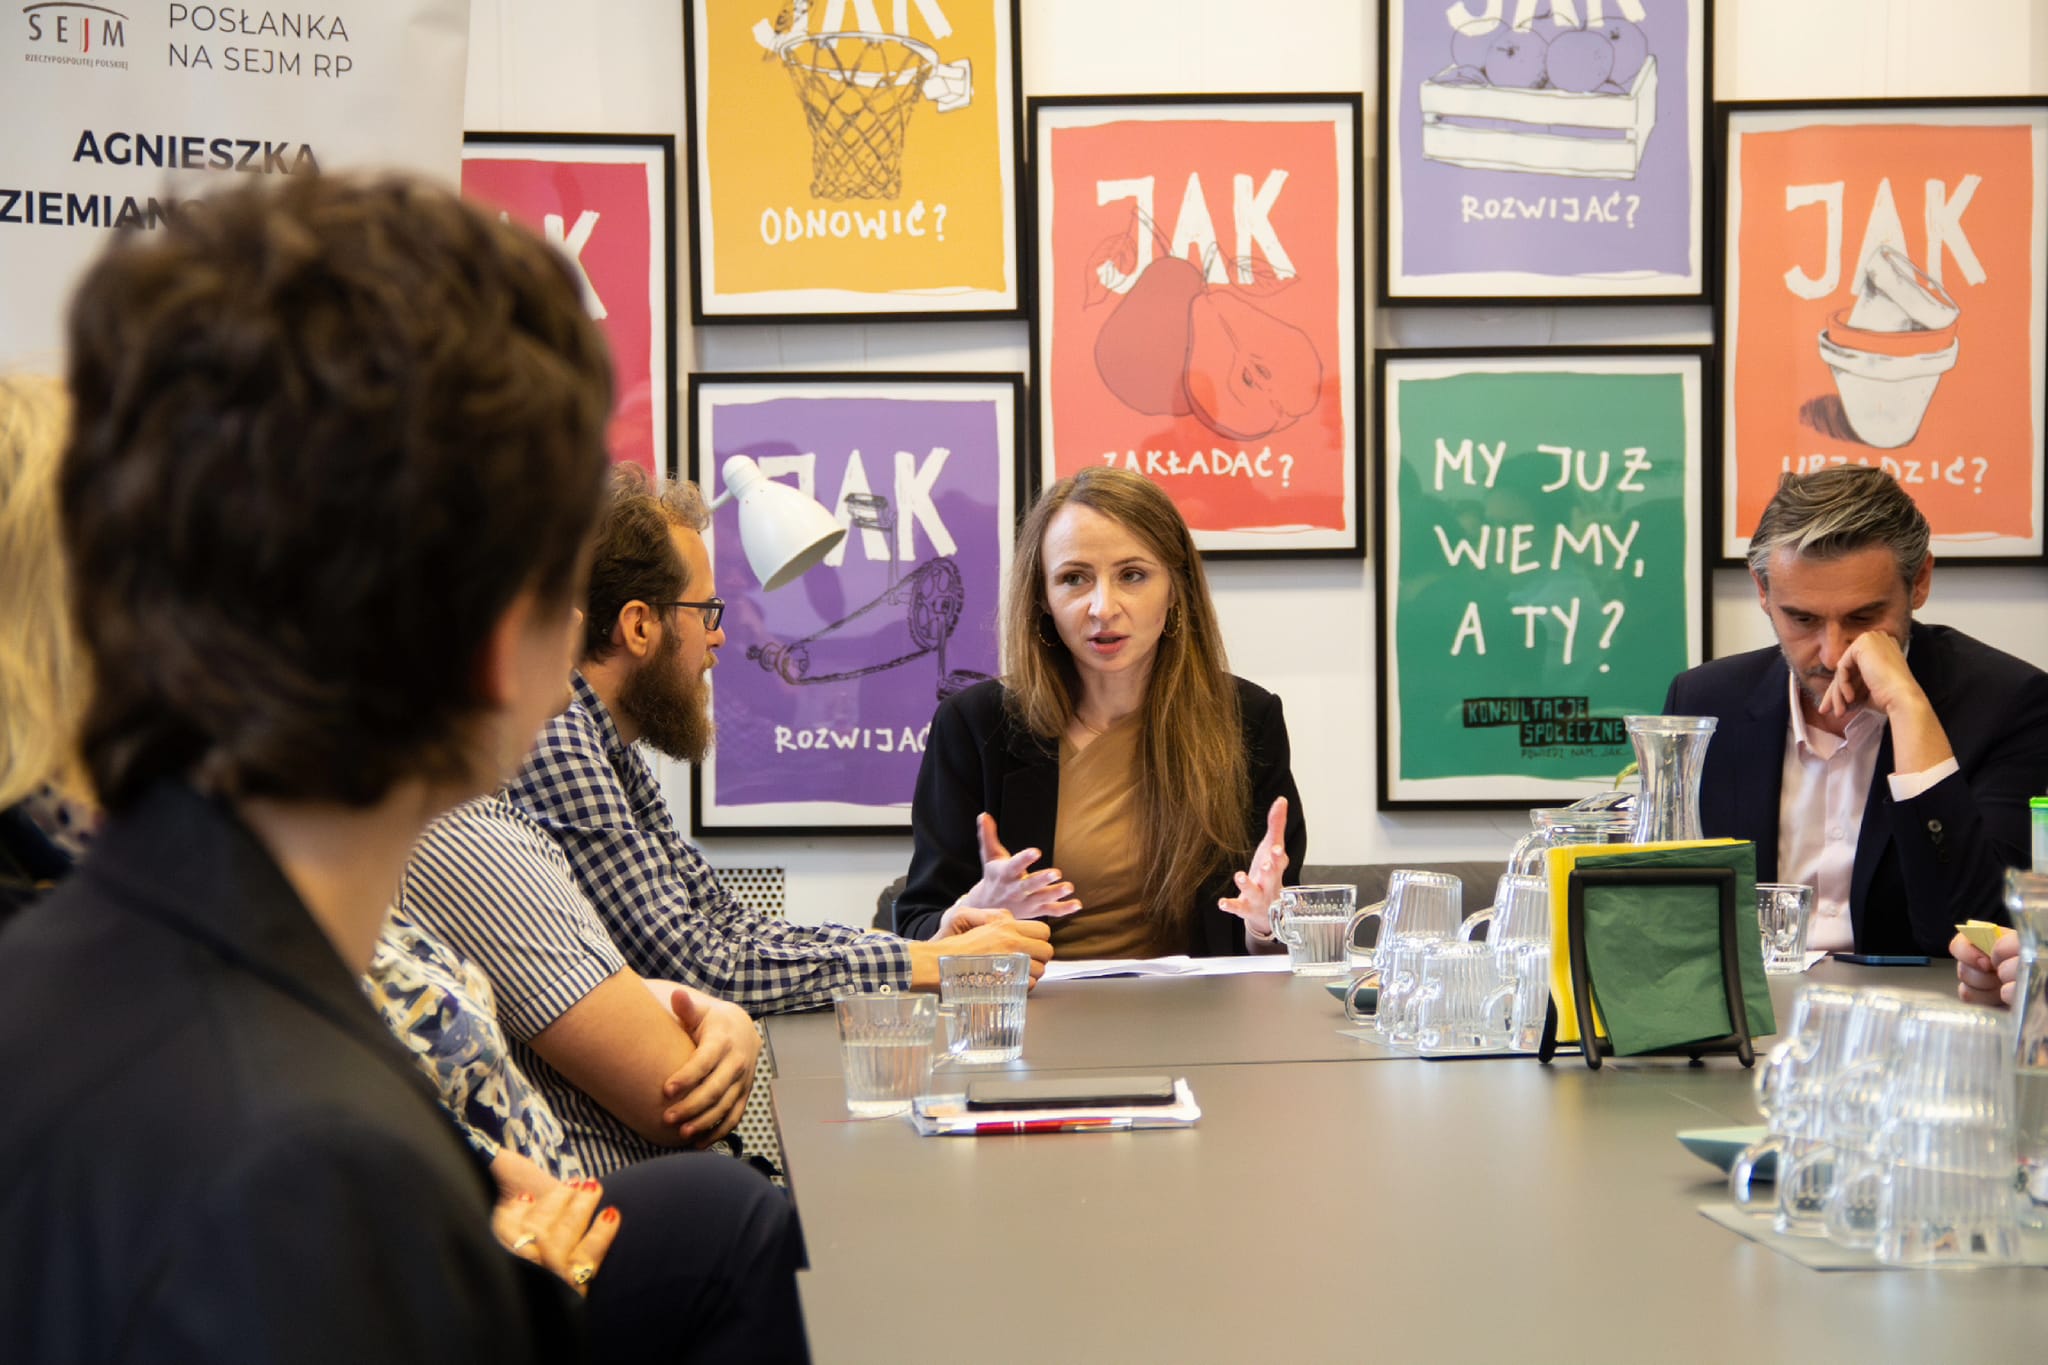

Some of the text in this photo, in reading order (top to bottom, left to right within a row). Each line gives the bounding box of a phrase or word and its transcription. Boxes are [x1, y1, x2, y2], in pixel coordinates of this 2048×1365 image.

[28, 13, 125, 52] SEJM
[169, 3, 349, 42] POSŁANKA
[168, 42, 353, 78] NA SEJM RP
[72, 130, 320, 176] AGNIESZKA
[760, 200, 948, 245] ODNOWIĆ?
[1461, 190, 1641, 228] ROZWIJAĆ?
[1097, 168, 1298, 294] JAK
[1783, 174, 1987, 300] JAK
[1434, 437, 1507, 491] MY
[1781, 454, 1989, 495] URDZIĆ?
[1450, 597, 1626, 673] A TY?
[1467, 699, 1588, 723] KONSULTACJE
[1523, 721, 1624, 745] SPOŁECZNE
